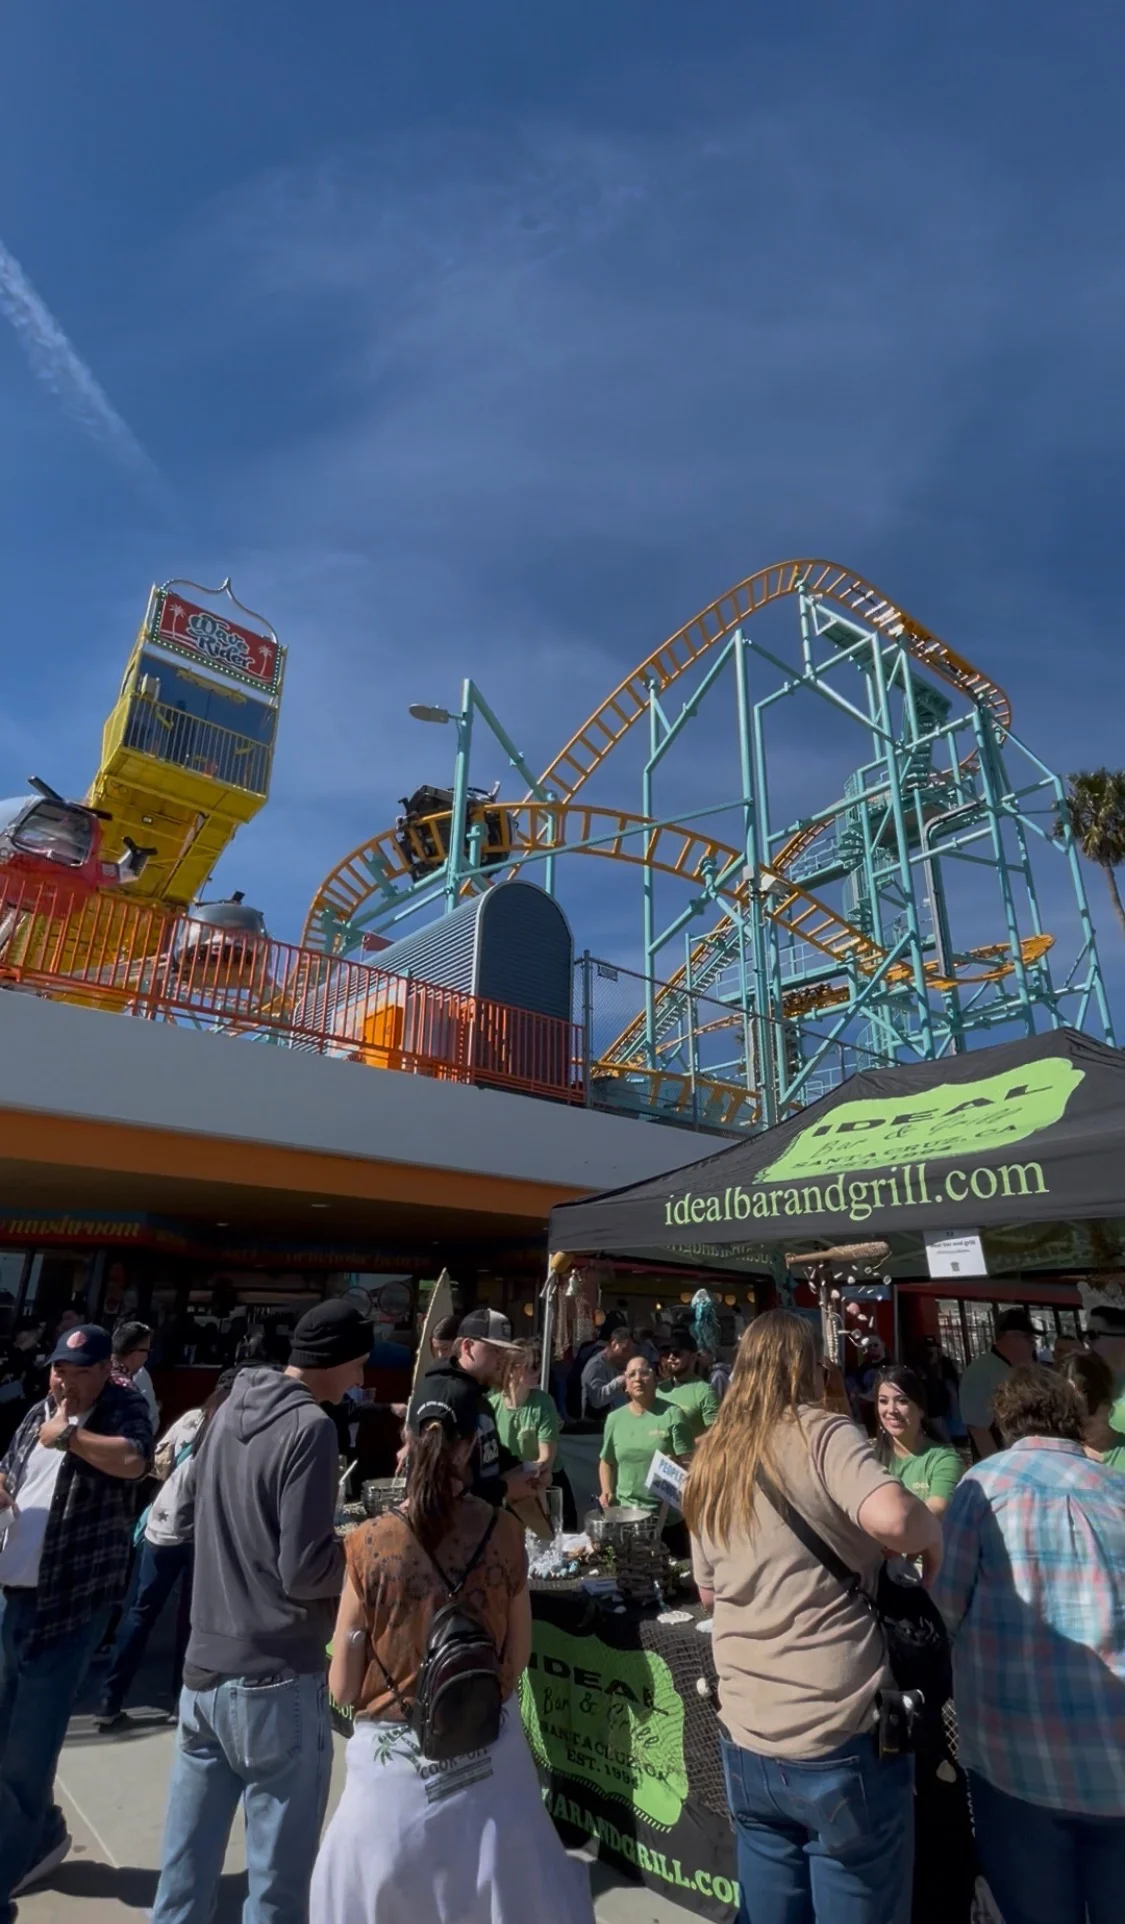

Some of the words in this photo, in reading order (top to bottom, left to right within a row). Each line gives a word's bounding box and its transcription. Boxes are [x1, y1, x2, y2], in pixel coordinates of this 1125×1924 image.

[187, 612, 250, 654] Wave
[198, 634, 256, 670] Rider
[810, 1138, 868, 1159] Bar
[884, 1124, 917, 1140] &
[929, 1107, 1023, 1136] Grill
[811, 1084, 1053, 1138] IDEAL
[790, 1151, 877, 1169] SANTA
[974, 1124, 1017, 1138] CA
[664, 1161, 1050, 1226] idealbarandgrill.com
[528, 1651, 669, 1717] IDEAL
[543, 1686, 571, 1715] Bar
[579, 1692, 599, 1714] &
[566, 1748, 601, 1773] EST.
